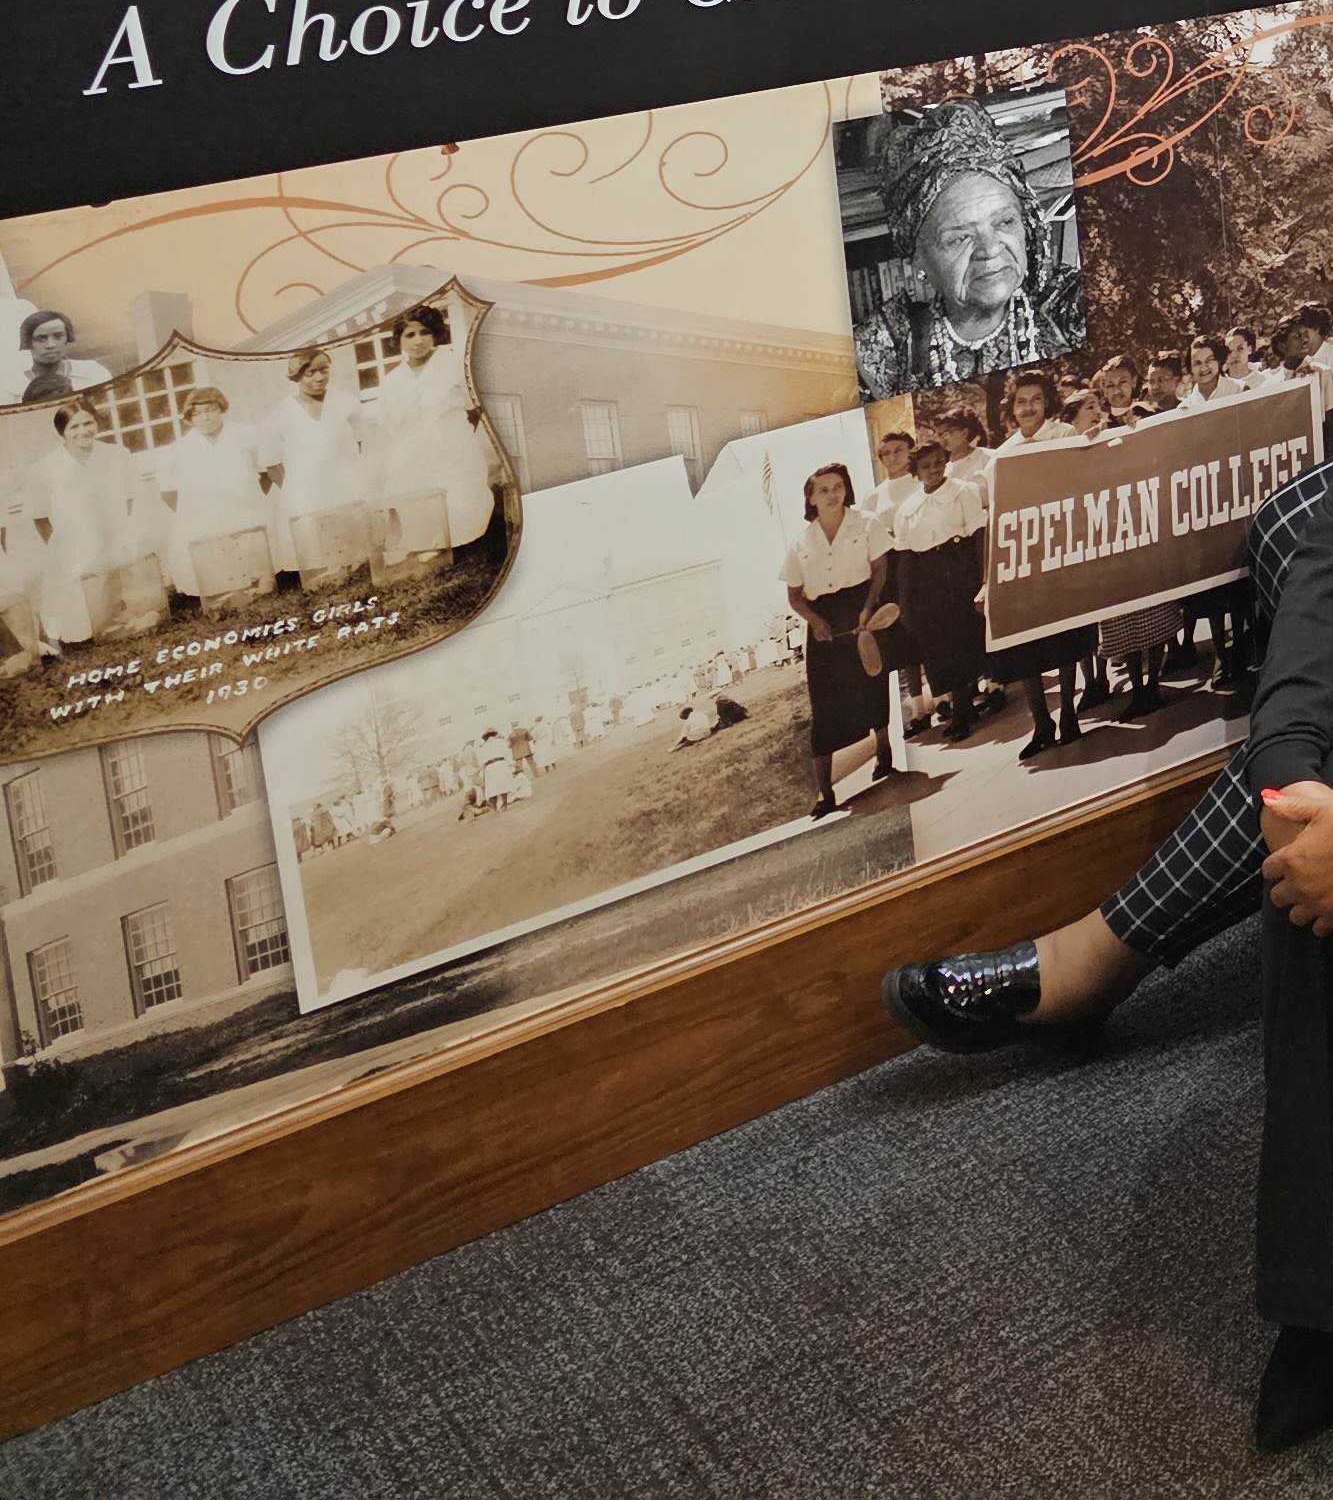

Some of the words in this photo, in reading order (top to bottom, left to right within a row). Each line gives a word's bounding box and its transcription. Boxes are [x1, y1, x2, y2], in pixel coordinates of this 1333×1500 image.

[83, 5, 162, 96] A
[997, 476, 1160, 584] SPELMAN
[1170, 436, 1308, 537] COLLEGE
[50, 689, 126, 720] WITH
[143, 661, 223, 694] THEIR
[242, 635, 321, 668] WHITE
[336, 612, 400, 640] RATS
[66, 659, 142, 689] HOME
[155, 617, 299, 665] ECONOMICS
[312, 595, 379, 623] GIRLS
[206, 674, 269, 705] 1930
